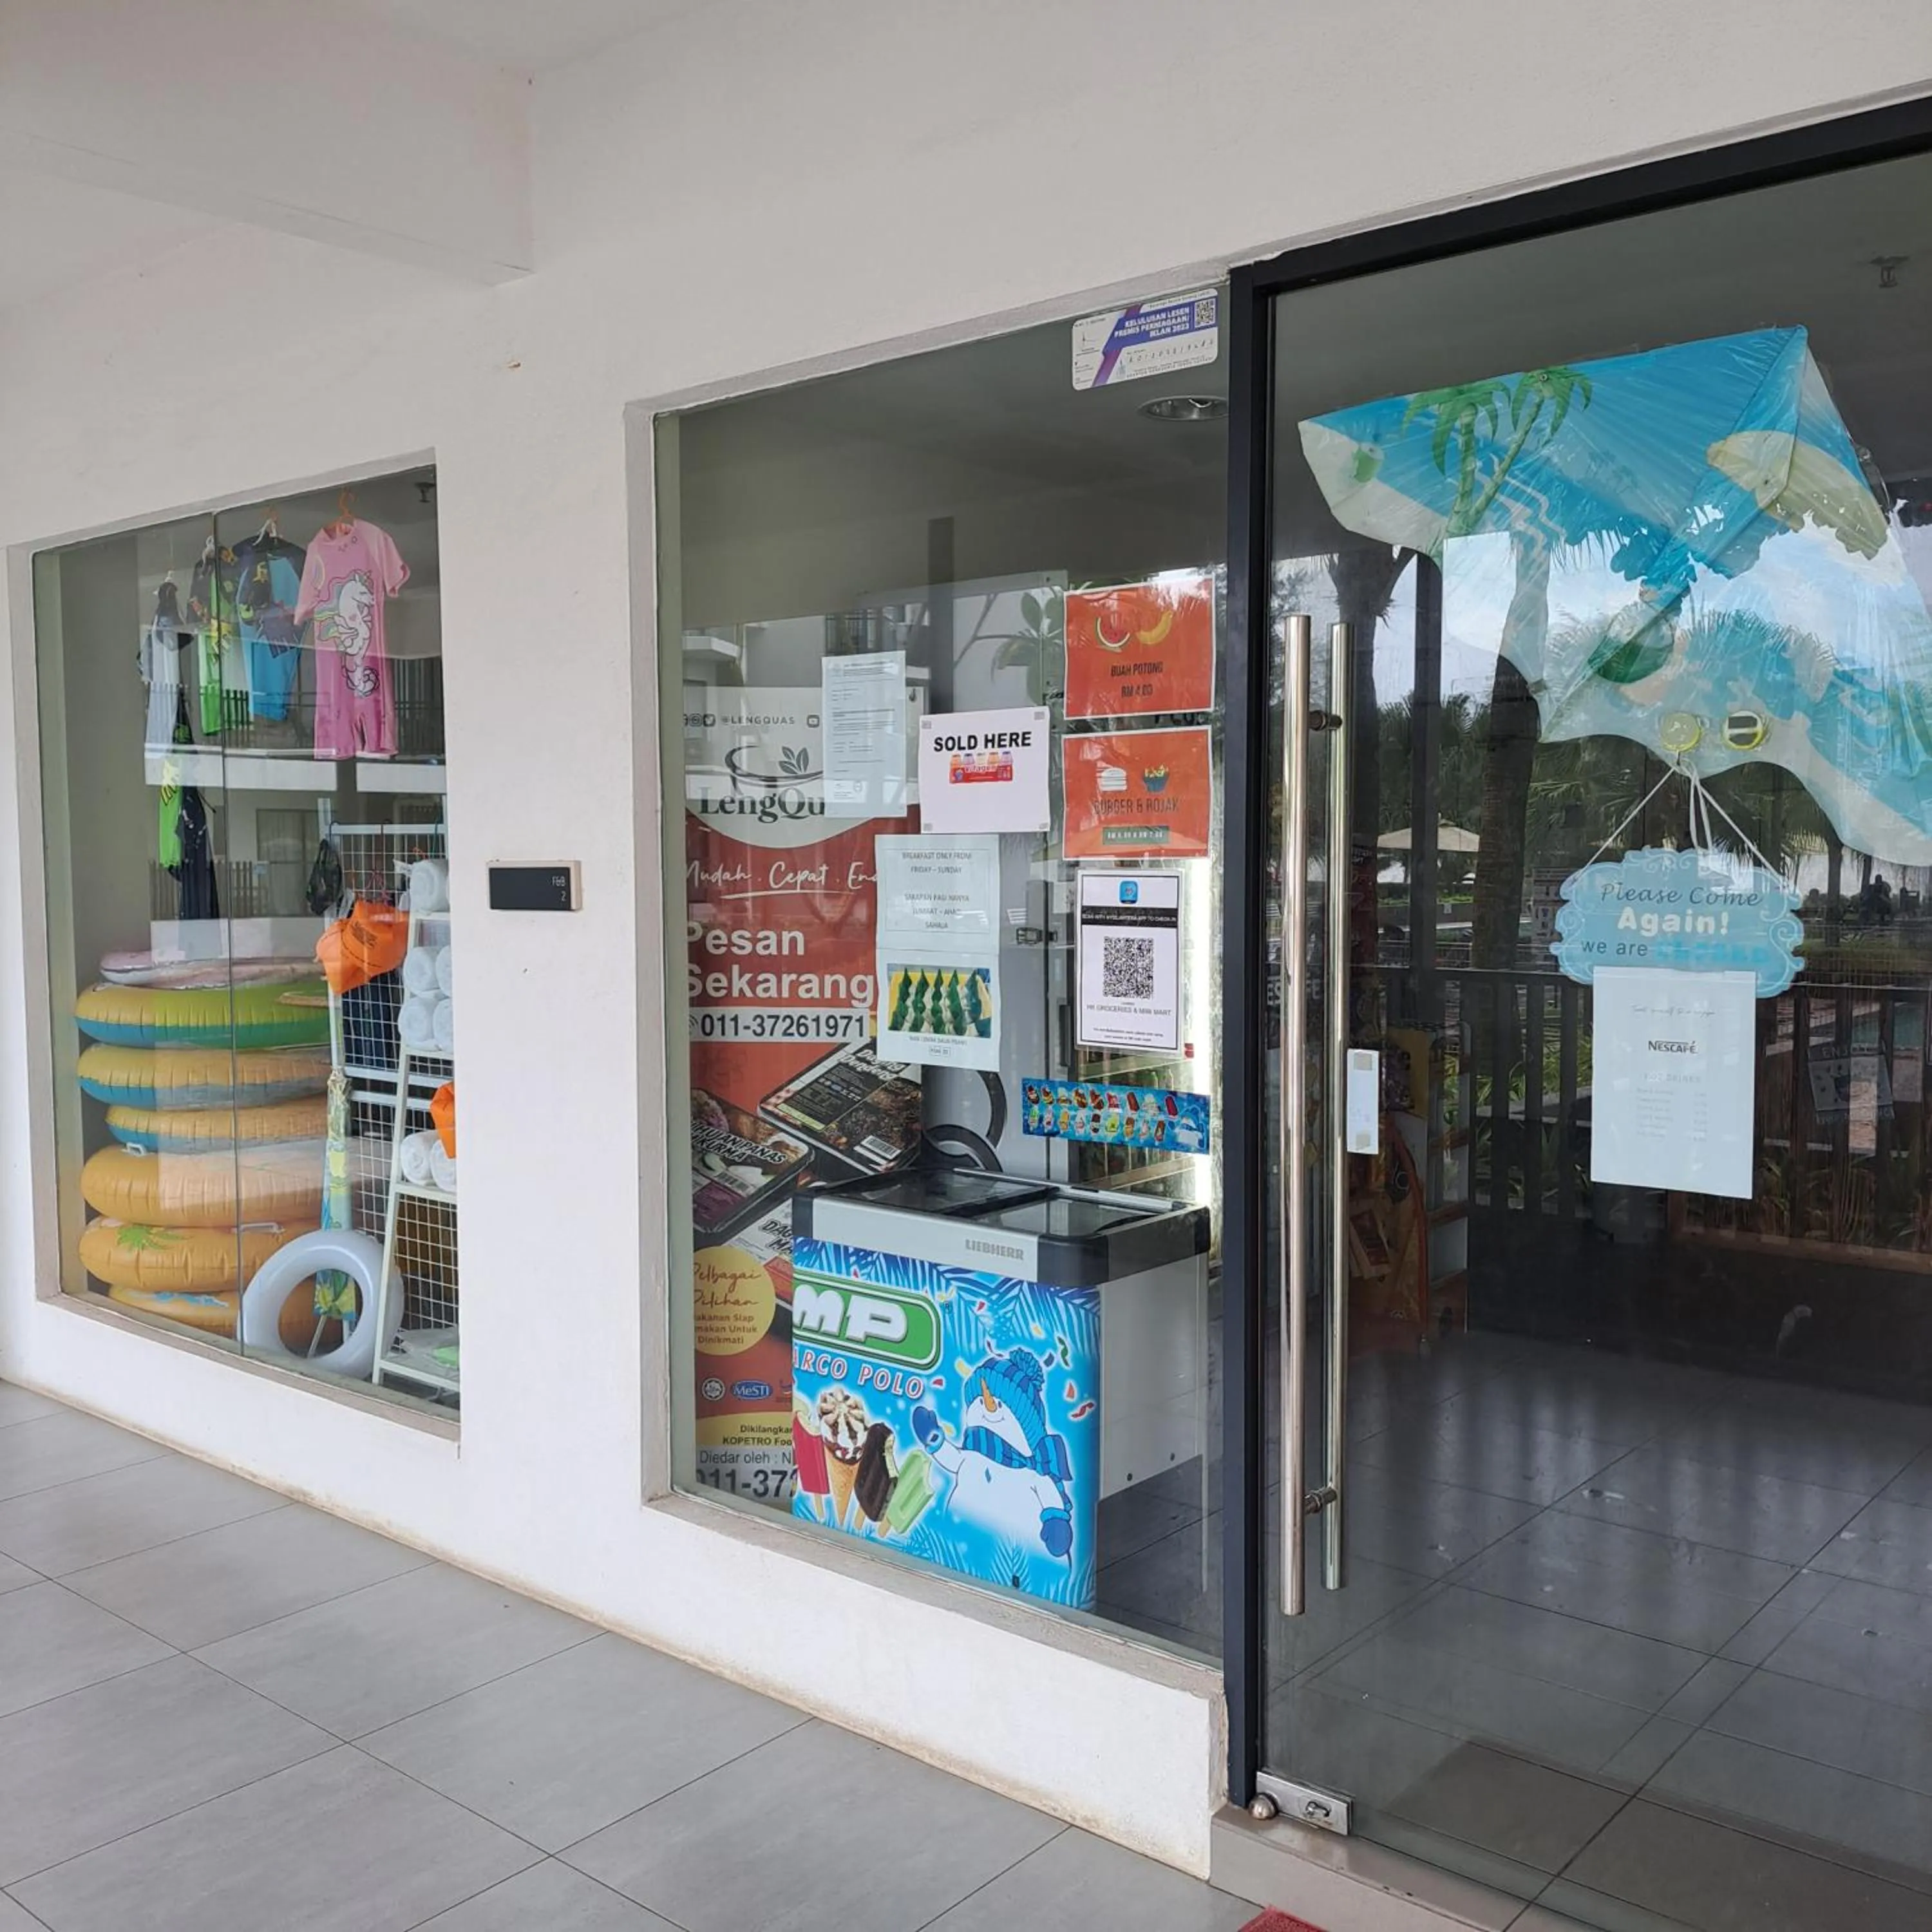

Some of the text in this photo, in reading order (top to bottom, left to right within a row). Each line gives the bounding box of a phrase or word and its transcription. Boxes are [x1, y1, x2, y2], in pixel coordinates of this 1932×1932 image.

[1114, 326, 1140, 338] PREMIS
[1150, 323, 1190, 337] IKLAN 2023
[1111, 661, 1164, 677] BUAH POTONG
[934, 731, 1032, 752] SOLD HERE
[699, 786, 825, 824] LengQu
[902, 851, 934, 860] BREAKFAST
[769, 861, 830, 891] Cepat
[848, 862, 878, 889] Ena
[1601, 883, 1763, 907] Please Come
[1617, 907, 1729, 937] Again!
[1582, 939, 1607, 954] we
[1616, 941, 1648, 956] are
[688, 963, 875, 1009] Sekarang
[700, 1014, 865, 1038] 011-37261971
[763, 1220, 793, 1240] DAG
[965, 1238, 1024, 1261] LIEBHERR
[792, 1283, 908, 1345] MP
[729, 1325, 758, 1333] Untuk
[697, 1336, 744, 1345] Dinikmati
[793, 1346, 925, 1399] RCO POLO
[733, 1386, 770, 1397] MeSTI
[723, 1437, 793, 1446] KOPETRO Foo
[699, 1450, 740, 1464] Diedar
[744, 1450, 770, 1464] oleh
[782, 1452, 792, 1464] N
